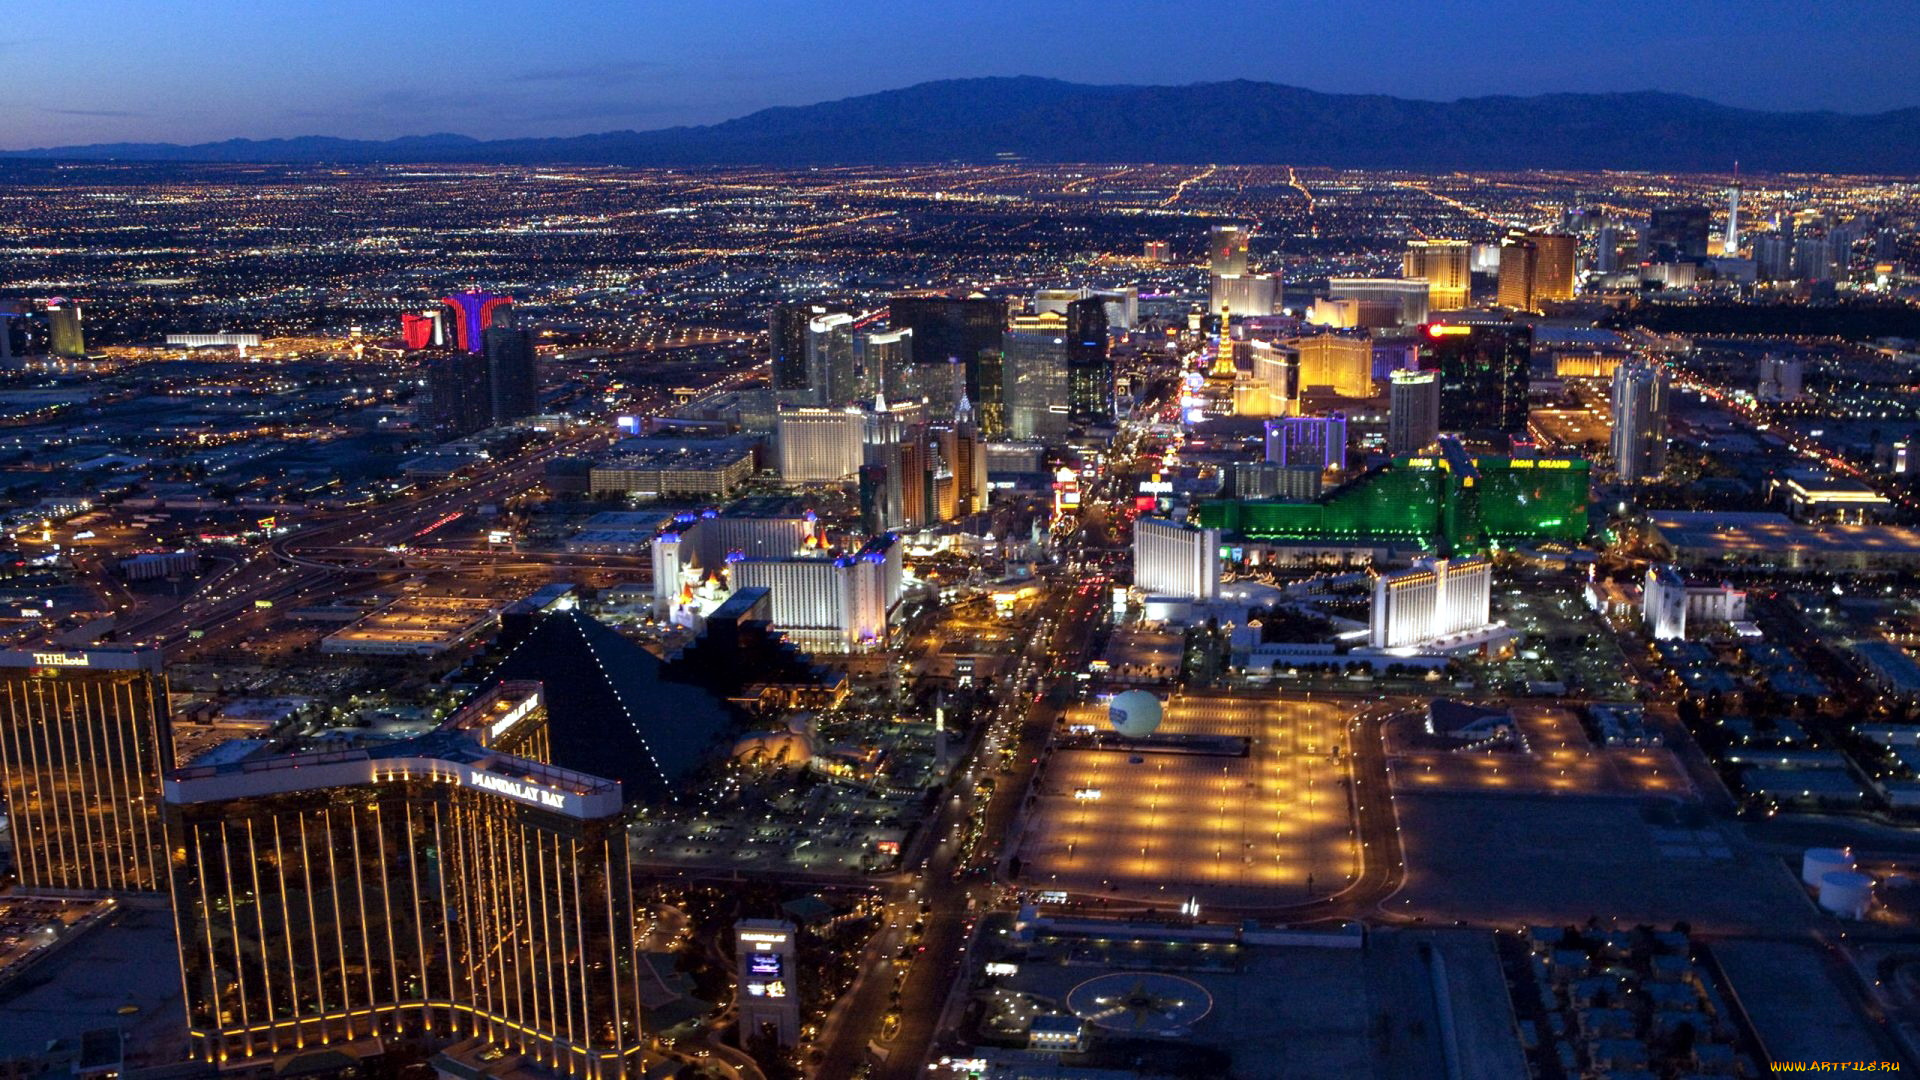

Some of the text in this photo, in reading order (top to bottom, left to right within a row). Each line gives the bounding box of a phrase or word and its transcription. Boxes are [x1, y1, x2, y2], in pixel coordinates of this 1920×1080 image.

[1510, 459, 1571, 469] MGM GRAND
[472, 772, 565, 808] MANDALAY BAY
